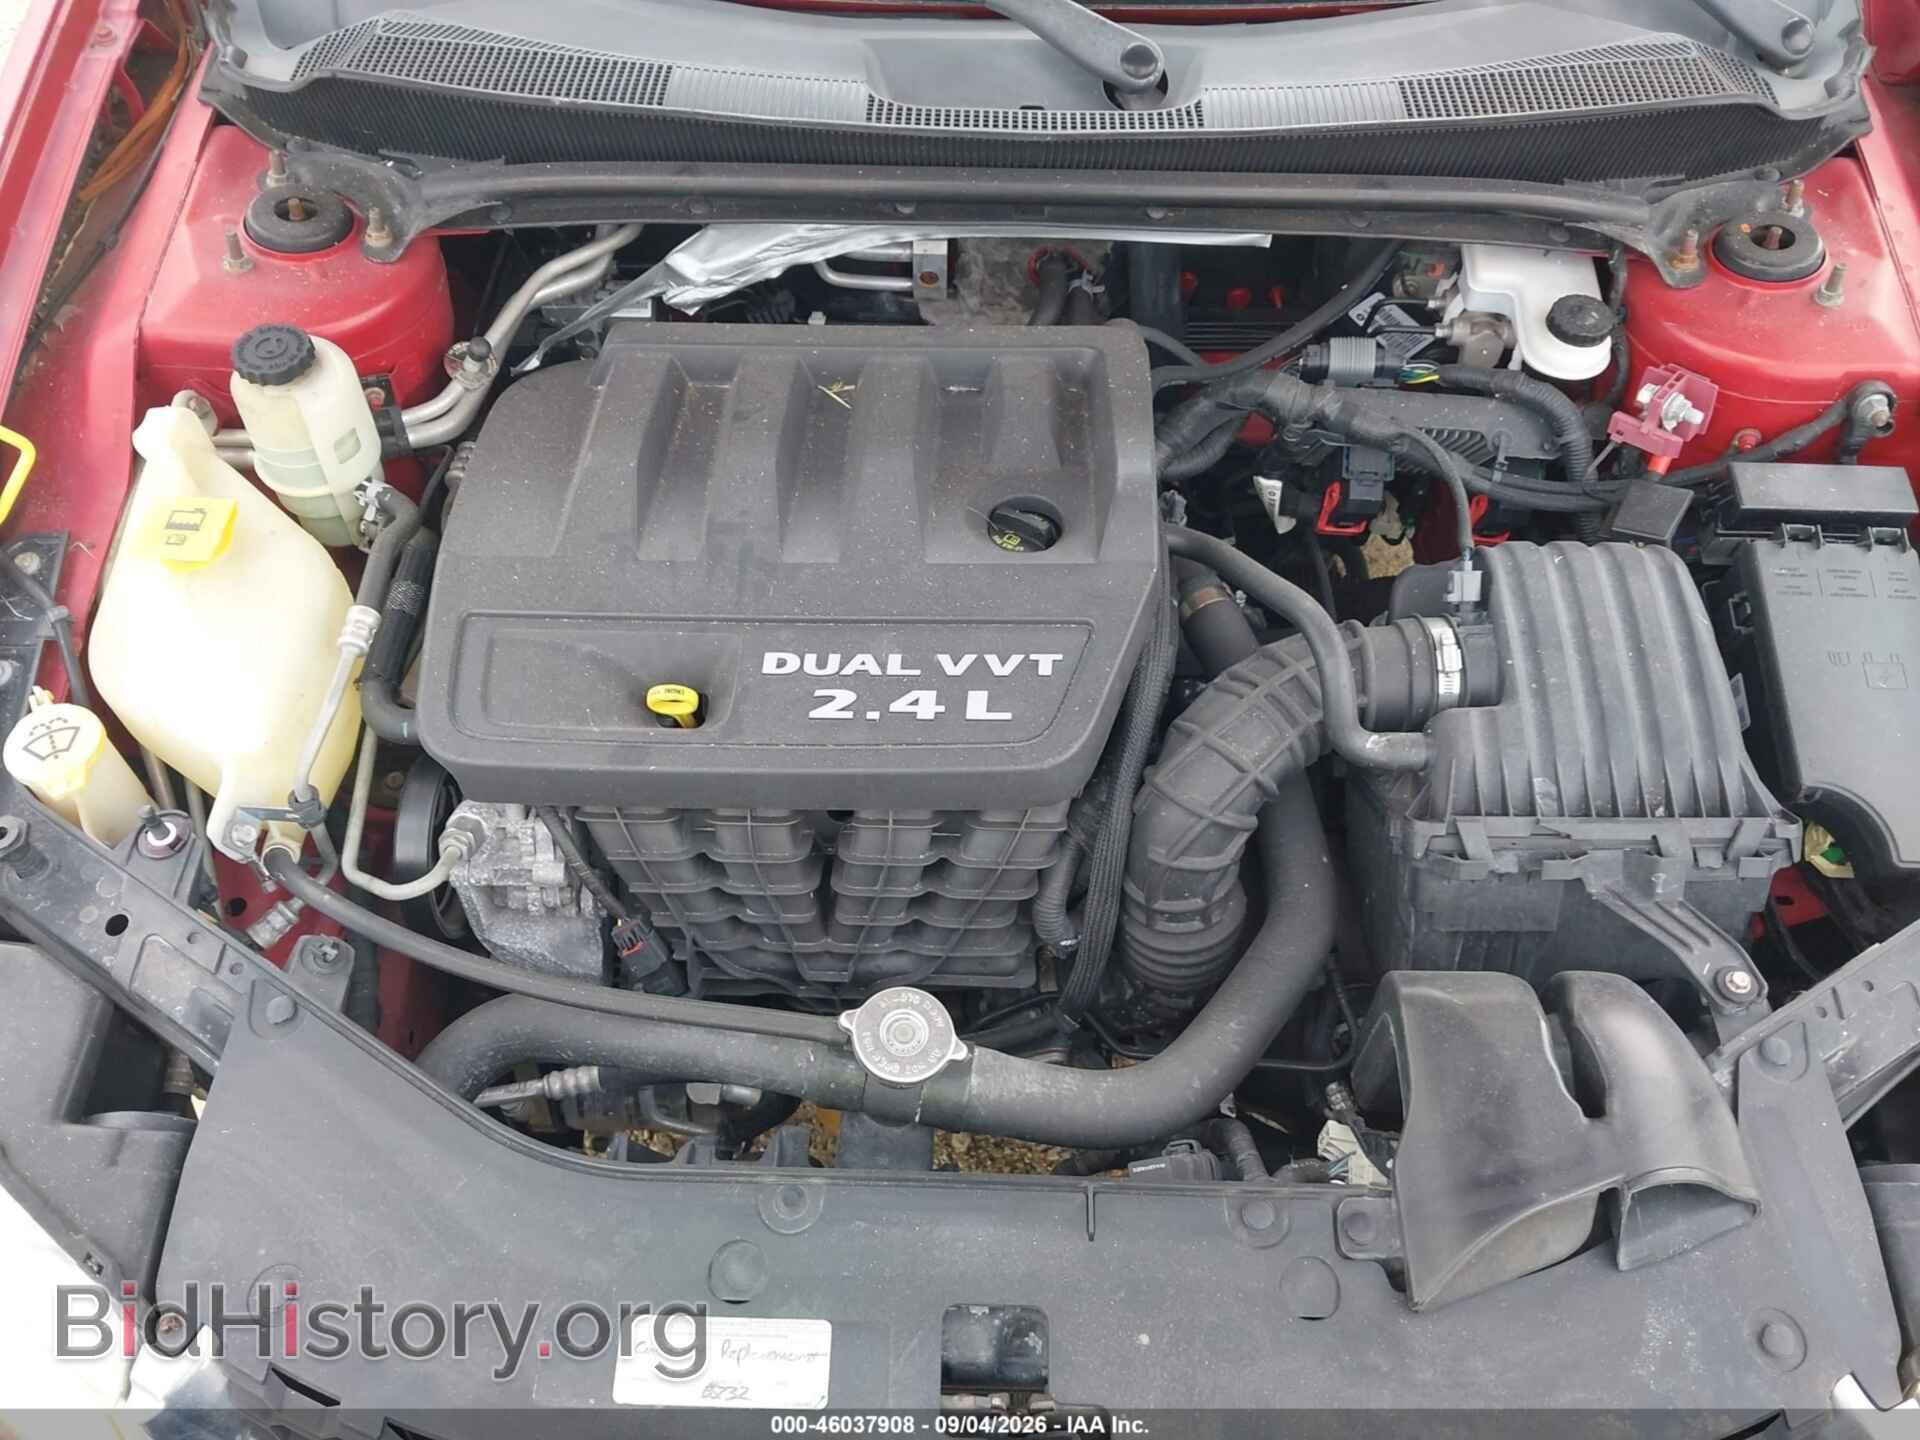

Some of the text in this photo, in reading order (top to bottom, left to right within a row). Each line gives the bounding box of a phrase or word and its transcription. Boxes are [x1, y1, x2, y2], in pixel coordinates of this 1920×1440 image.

[761, 652, 1064, 676] DUAL VVT
[808, 688, 1013, 720] 2.4 L
